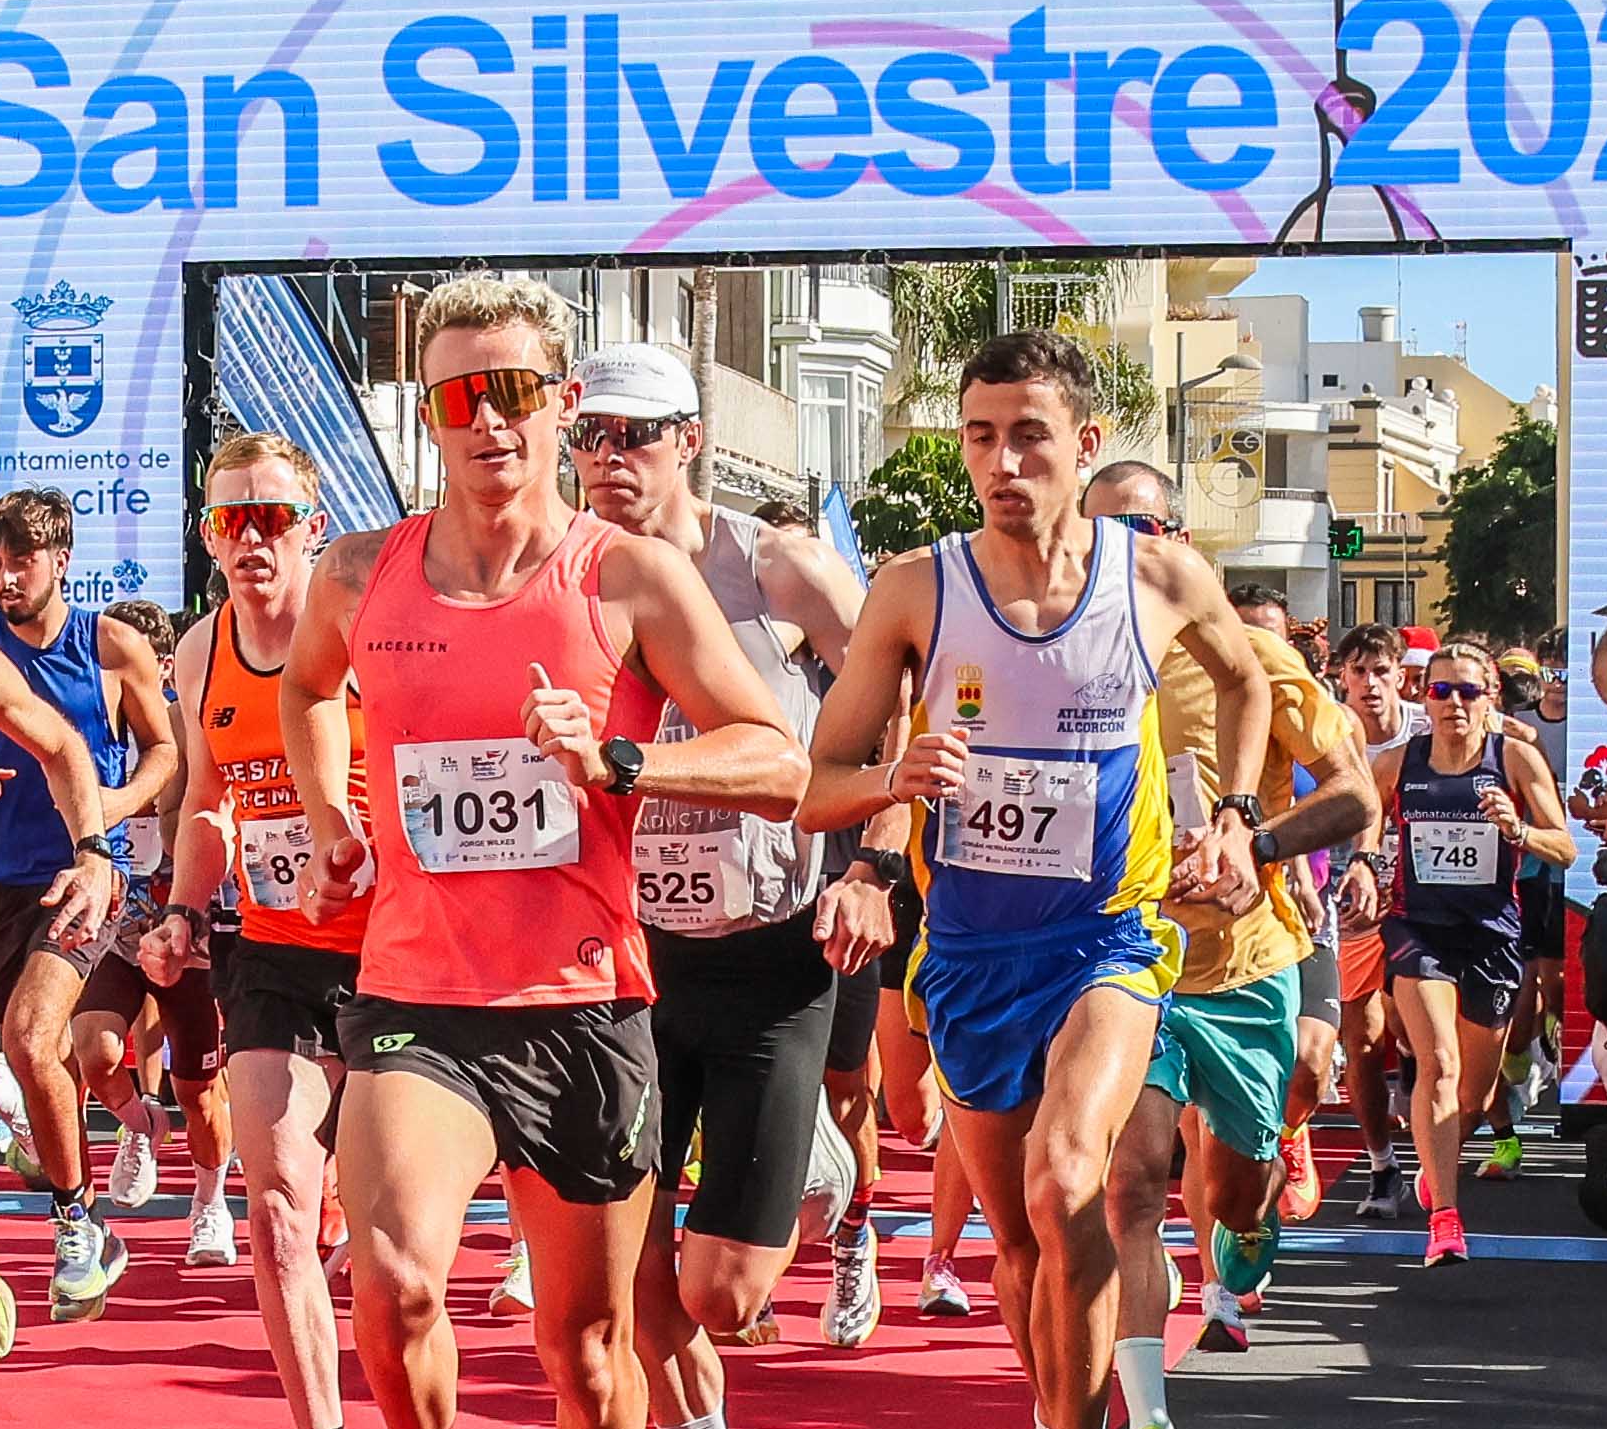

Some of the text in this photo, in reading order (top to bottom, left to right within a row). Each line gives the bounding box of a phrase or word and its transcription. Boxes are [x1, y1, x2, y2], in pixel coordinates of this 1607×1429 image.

[377, 6, 1278, 206] Silvestre
[138, 447, 171, 469] de
[1056, 718, 1125, 733] ALCORCÓN
[1057, 707, 1126, 720] ATLETISMO
[421, 788, 547, 837] 1031
[967, 800, 1059, 844] 497
[1430, 846, 1479, 868] 748
[638, 871, 715, 905] 525
